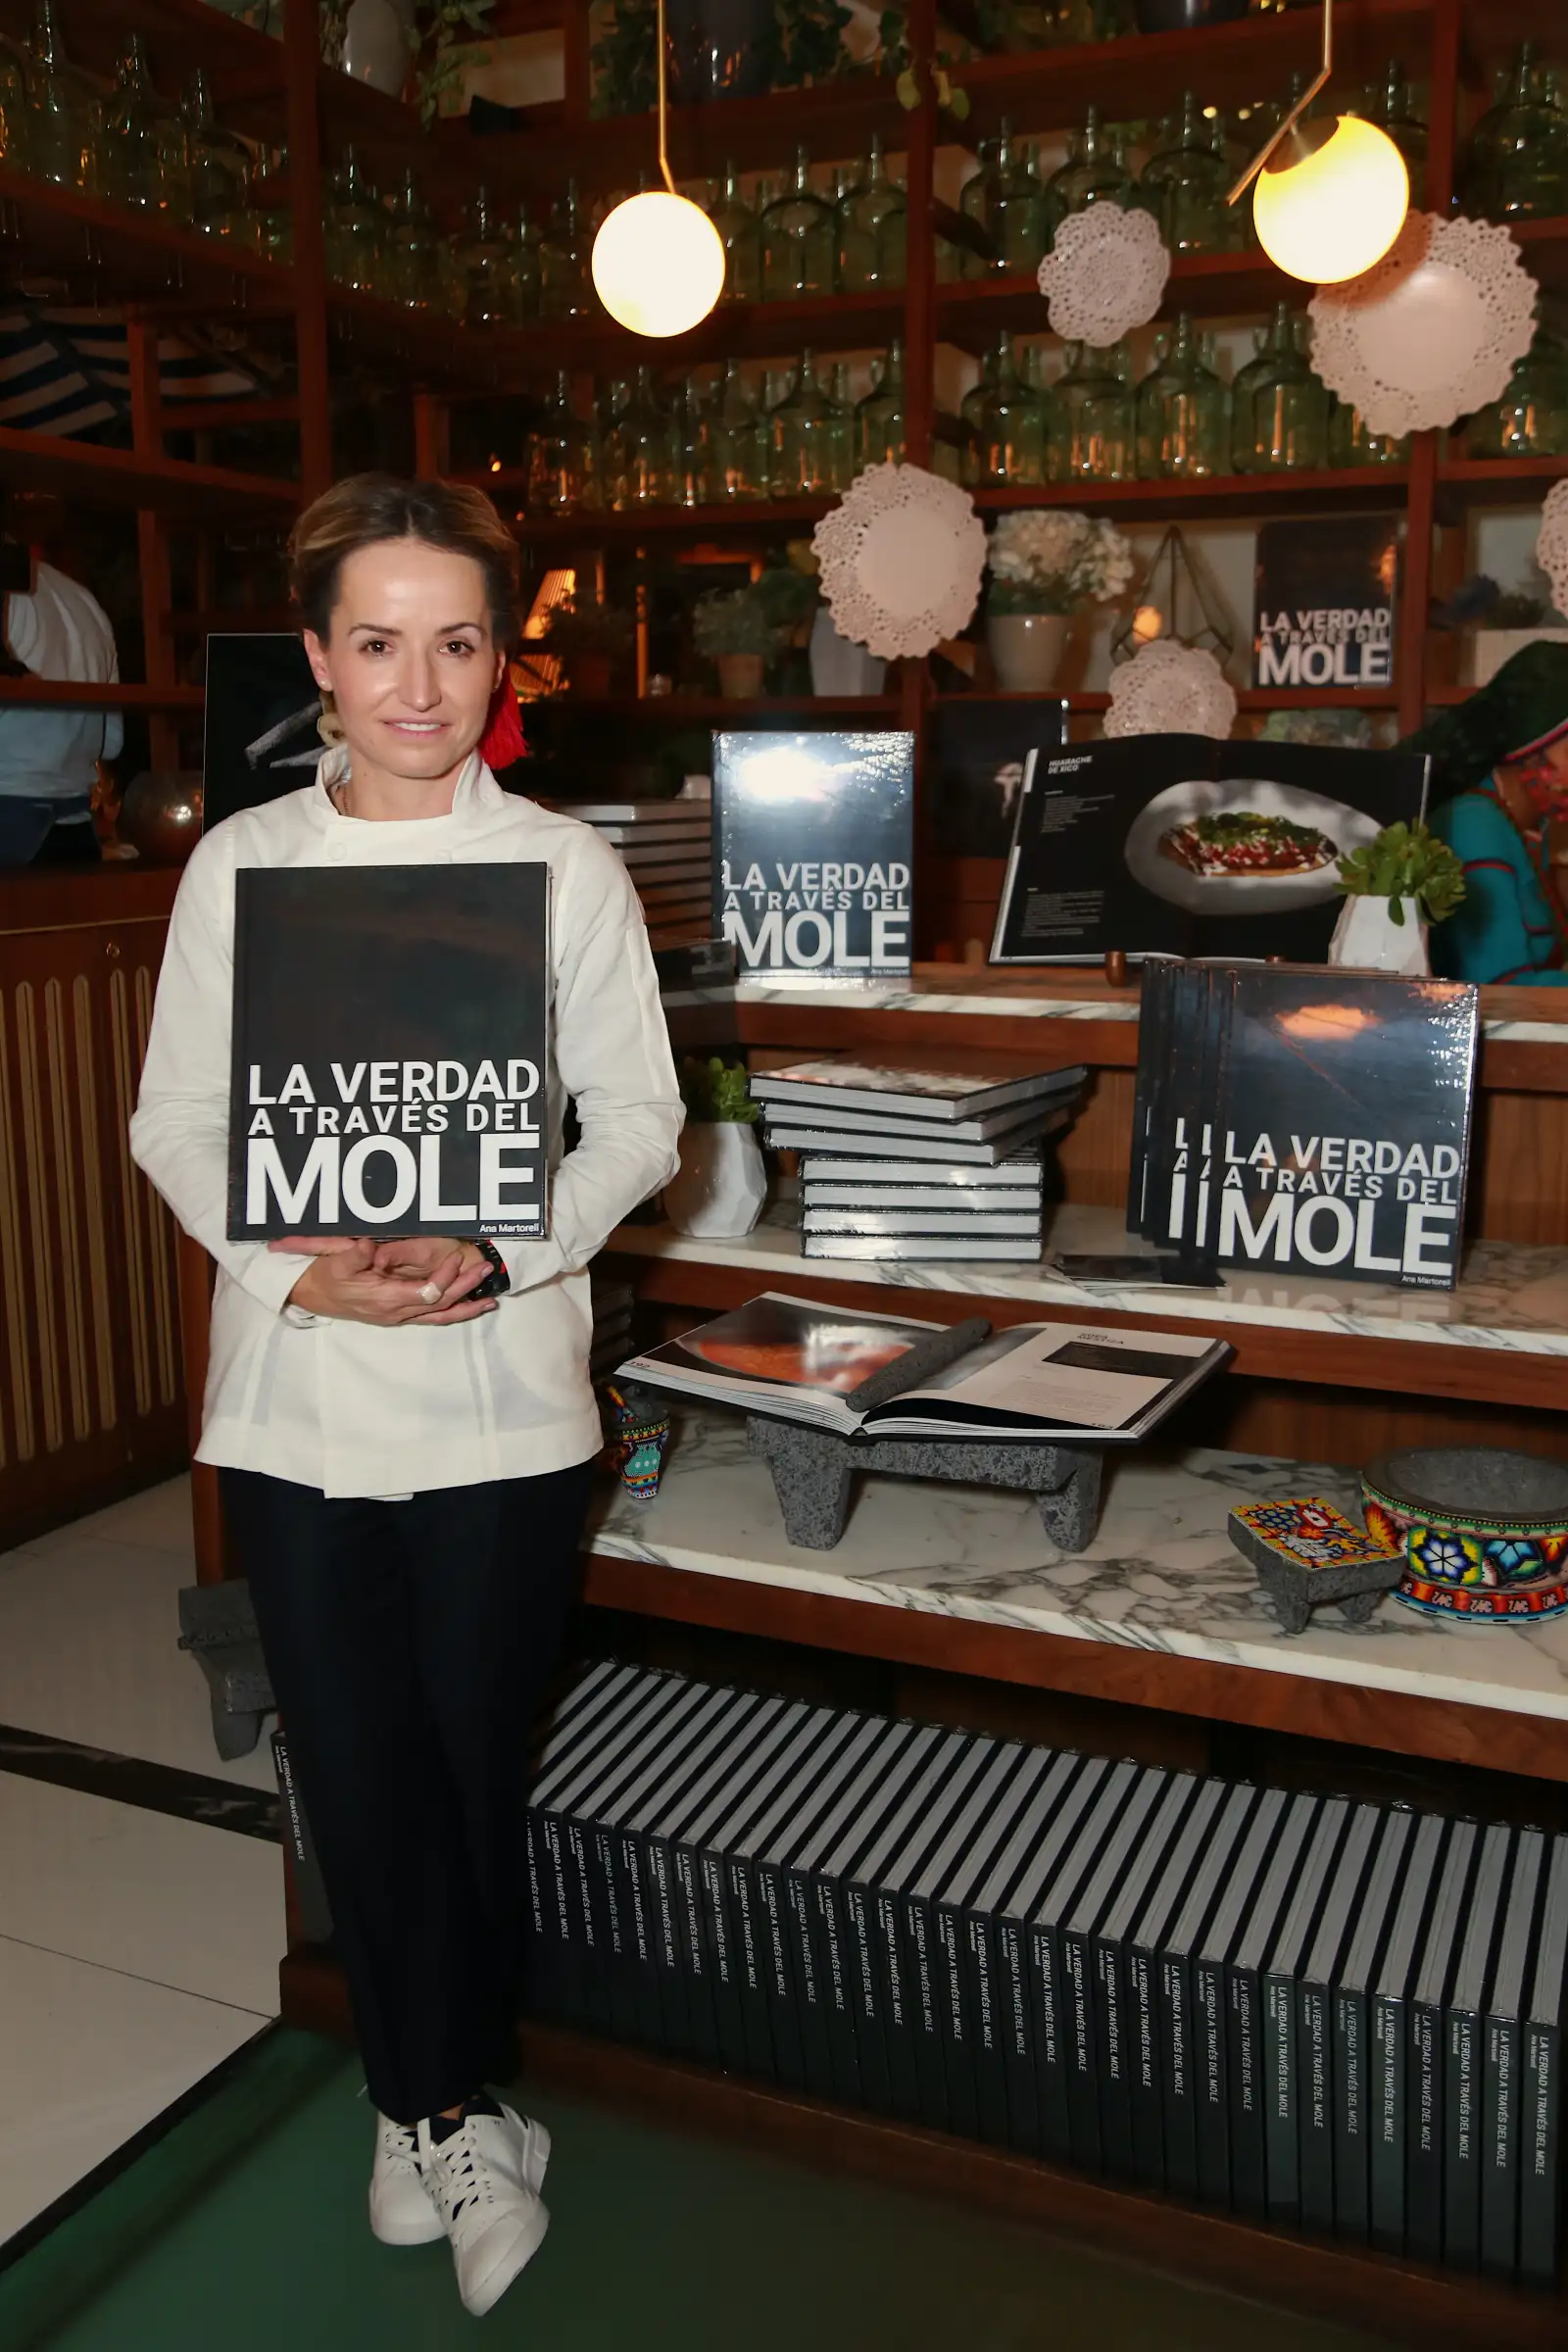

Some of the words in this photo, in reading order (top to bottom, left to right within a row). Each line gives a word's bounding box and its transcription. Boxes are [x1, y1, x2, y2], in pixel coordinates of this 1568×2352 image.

[1260, 611, 1291, 632] LA
[1297, 608, 1390, 630] VERDAD
[1259, 642, 1389, 685] MOLE
[724, 863, 766, 891] LA
[776, 862, 909, 891] VERDAD
[724, 892, 740, 910] A
[752, 886, 852, 910] TRAVÉS
[863, 892, 909, 910] DEL
[724, 910, 910, 969] MOLE
[249, 1064, 316, 1105] LA
[330, 1059, 540, 1103] VERDAD
[248, 1108, 274, 1135] A
[289, 1098, 448, 1134] TRAVÉS
[466, 1102, 540, 1132] DEL
[1225, 1131, 1277, 1167] LA
[1291, 1135, 1460, 1179] VERDAD
[246, 1132, 540, 1225] MOLE
[1223, 1166, 1243, 1189] A
[1256, 1167, 1383, 1199] TRAVÉS
[1396, 1180, 1457, 1205] DEL
[479, 1225, 497, 1233] Ana
[1218, 1189, 1457, 1277] MOLE
[1401, 1275, 1416, 1283] Ana
[573, 1827, 581, 1837] LA
[575, 1839, 585, 1870] VERDAD
[654, 1847, 662, 1857] LA
[656, 1859, 666, 1890] VERDAD
[708, 1861, 716, 1871] LA
[710, 1873, 720, 1904] VERDAD
[765, 1873, 773, 1884] LA
[823, 1885, 831, 1896] LA
[580, 1879, 590, 1907] TRAVÉS
[767, 1886, 777, 1917] VERDAD
[884, 1899, 892, 1910] LA
[583, 1908, 591, 1921] DEL
[660, 1898, 671, 1928] TRAVÉS
[824, 1898, 835, 1930] VERDAD
[945, 1914, 953, 1925] LA
[585, 1924, 594, 1945] MOLE
[663, 1929, 672, 1943] DEL
[714, 1913, 725, 1943] TRAVÉS
[885, 1912, 895, 1944] VERDAD
[975, 1922, 984, 1933] LA
[717, 1943, 725, 1958] DEL
[771, 1926, 782, 1956] TRAVÉS
[946, 1927, 956, 1959] VERDAD
[976, 1935, 987, 1967] VERDAD
[1040, 1936, 1049, 1946] LA
[665, 1944, 674, 1966] MOLE
[774, 1957, 783, 1971] DEL
[829, 1939, 840, 1969] TRAVÉS
[1041, 1949, 1051, 1981] VERDAD
[1105, 1950, 1114, 1961] LA
[719, 1960, 728, 1982] MOLE
[832, 1970, 841, 1985] DEL
[889, 1953, 900, 1984] TRAVÉS
[1106, 1964, 1115, 1996] VERDAD
[1171, 1965, 1179, 1976] LA
[1205, 1972, 1214, 1982] LA
[776, 1973, 785, 1995] MOLE
[891, 1985, 900, 1999] DEL
[949, 1968, 960, 1999] TRAVÉS
[980, 1977, 991, 2007] TRAVÉS
[1171, 1979, 1181, 2011] VERDAD
[1277, 1986, 1286, 1997] LA
[834, 1987, 844, 2009] MOLE
[951, 2000, 960, 2014] DEL
[1043, 1991, 1054, 2022] TRAVÉS
[1206, 1985, 1215, 2018] VERDAD
[893, 2001, 902, 2024] MOLE
[981, 2008, 990, 2023] DEL
[1108, 2006, 1118, 2037] TRAVÉS
[1277, 1999, 1287, 2033] VERDAD
[1385, 2008, 1394, 2019] LA
[952, 2017, 962, 2039] MOLE
[983, 2025, 992, 2048] MOLE
[1045, 2022, 1054, 2038] DEL
[1172, 2021, 1184, 2053] TRAVÉS
[1384, 2022, 1394, 2056] VERDAD
[1460, 2023, 1470, 2034] LA
[1046, 2039, 1055, 2062] MOLE
[1109, 2038, 1117, 2053] DEL
[1207, 2028, 1218, 2060] TRAVÉS
[1460, 2036, 1470, 2071] VERDAD
[1539, 2036, 1549, 2048] LA
[1110, 2055, 1119, 2078] MOLE
[1173, 2053, 1182, 2069] DEL
[1208, 2061, 1217, 2076] DEL
[1278, 2043, 1289, 2075] TRAVÉS
[1537, 2050, 1548, 2086] VERDAD
[1174, 2071, 1183, 2094] MOLE
[1209, 2078, 1218, 2102] MOLE
[1278, 2076, 1287, 2091] DEL
[1384, 2066, 1395, 2099] TRAVÉS
[1278, 2093, 1287, 2117] MOLE
[1384, 2099, 1393, 2115] DEL
[1459, 2082, 1470, 2114] TRAVÉS
[1459, 2116, 1469, 2132] DEL
[1536, 2096, 1547, 2130] TRAVÉS
[1383, 2117, 1393, 2142] MOLE
[1535, 2131, 1546, 2147] DEL
[1458, 2133, 1469, 2158] MOLE
[1534, 2149, 1545, 2175] MOLE
